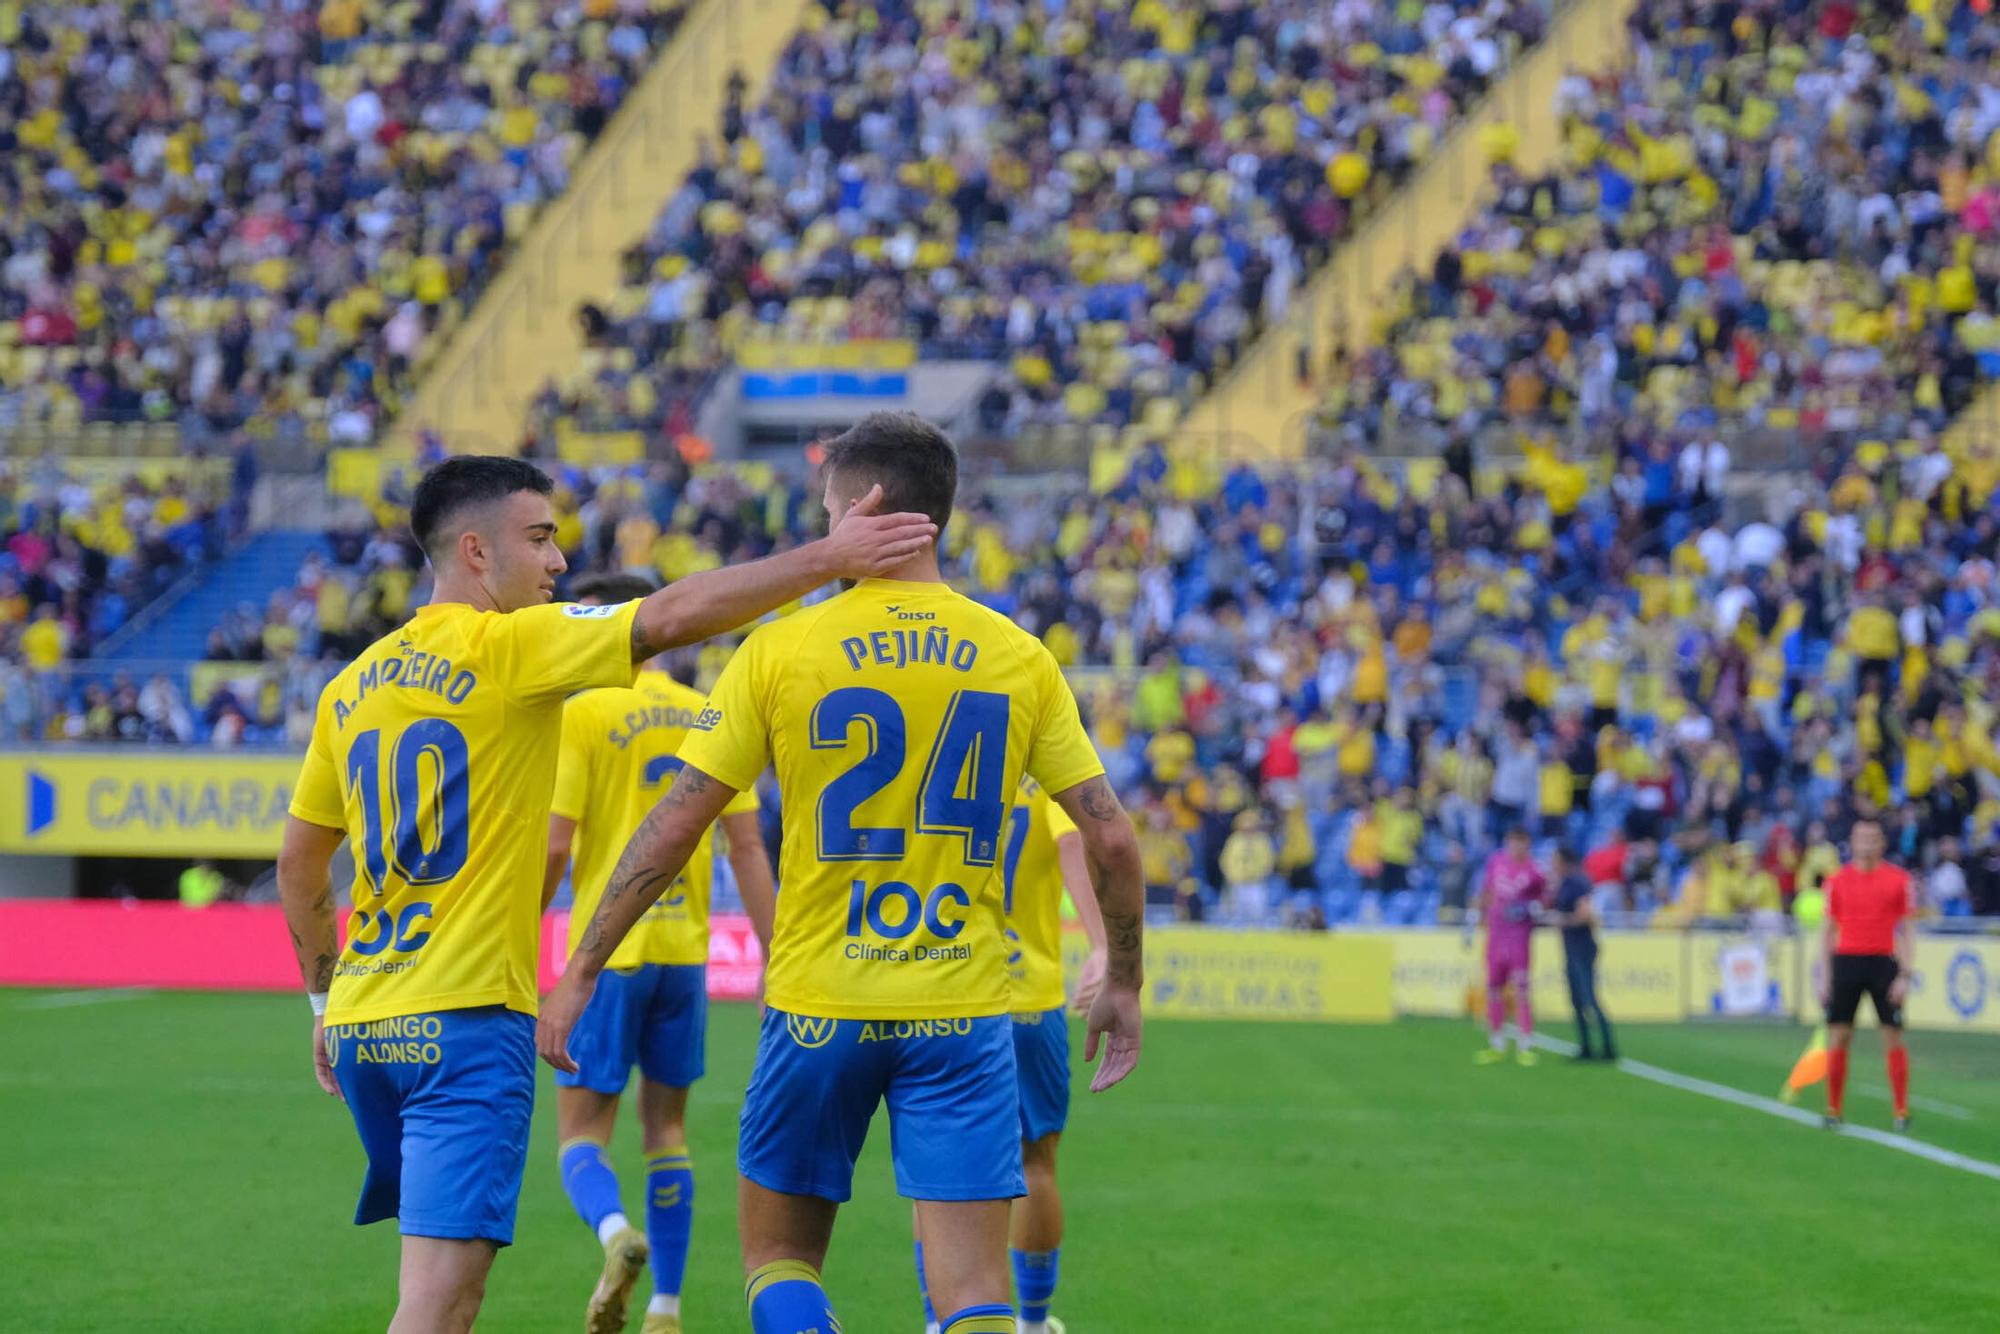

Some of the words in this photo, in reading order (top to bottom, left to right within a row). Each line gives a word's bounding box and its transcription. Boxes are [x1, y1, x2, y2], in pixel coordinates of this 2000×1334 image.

[841, 625, 978, 672] PEJIÑO
[608, 706, 694, 749] S.CARDO
[696, 701, 723, 726] ise
[809, 686, 1010, 866] 24
[86, 776, 294, 832] CANARA
[346, 718, 470, 896] 10
[350, 901, 433, 956] OC
[846, 880, 970, 939] IOC
[845, 943, 909, 962] Clínica
[914, 943, 972, 961] Dental
[340, 1016, 442, 1039] DOMINGO
[858, 1017, 972, 1044] ALONSO
[356, 1042, 442, 1064] ALONSO
